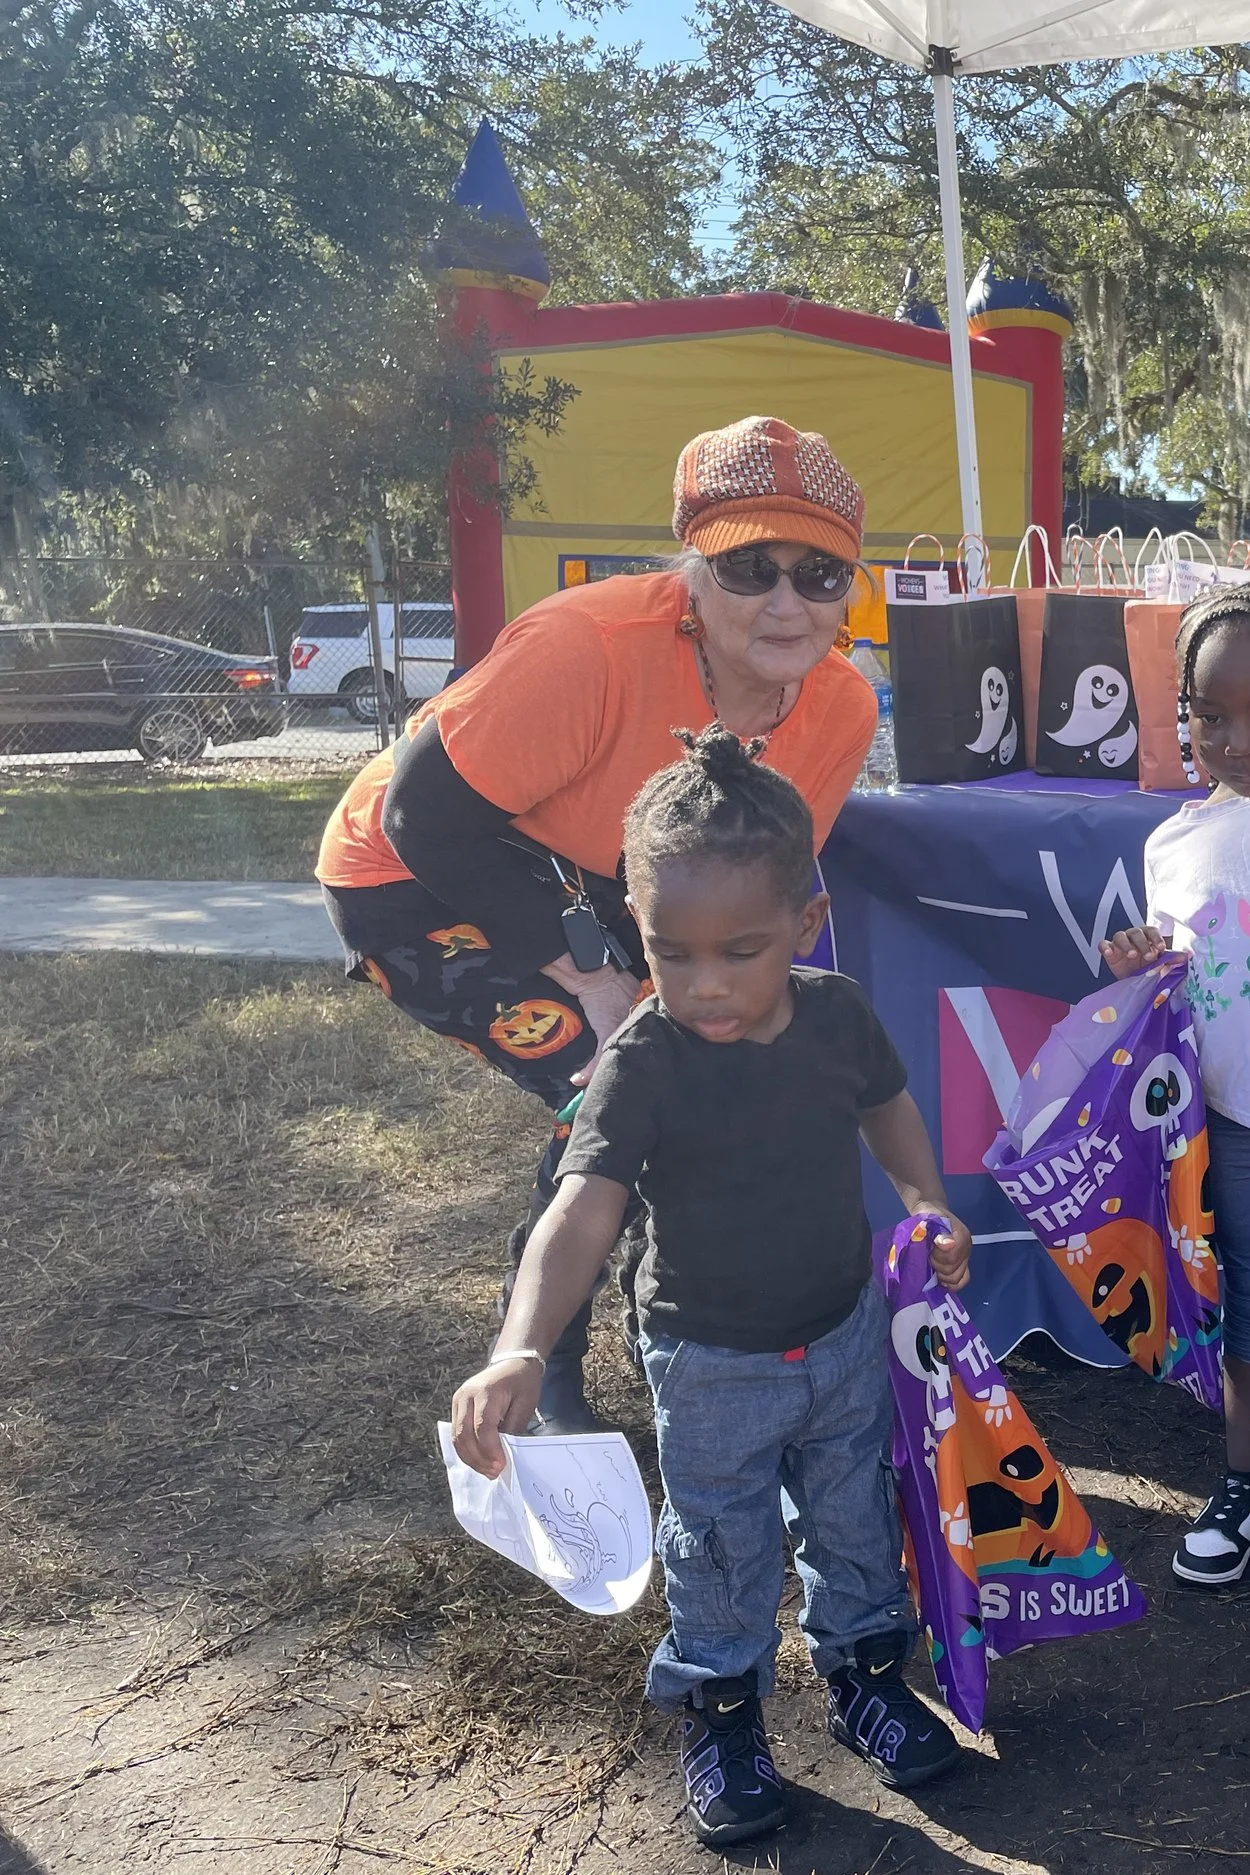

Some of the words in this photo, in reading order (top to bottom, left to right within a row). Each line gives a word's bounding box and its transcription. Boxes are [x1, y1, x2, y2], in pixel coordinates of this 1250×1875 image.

[995, 1123, 1108, 1206] RUNK
[1026, 1133, 1124, 1233] TREAT
[1019, 1590, 1041, 1622] IS
[1050, 1573, 1131, 1617] SWEET
